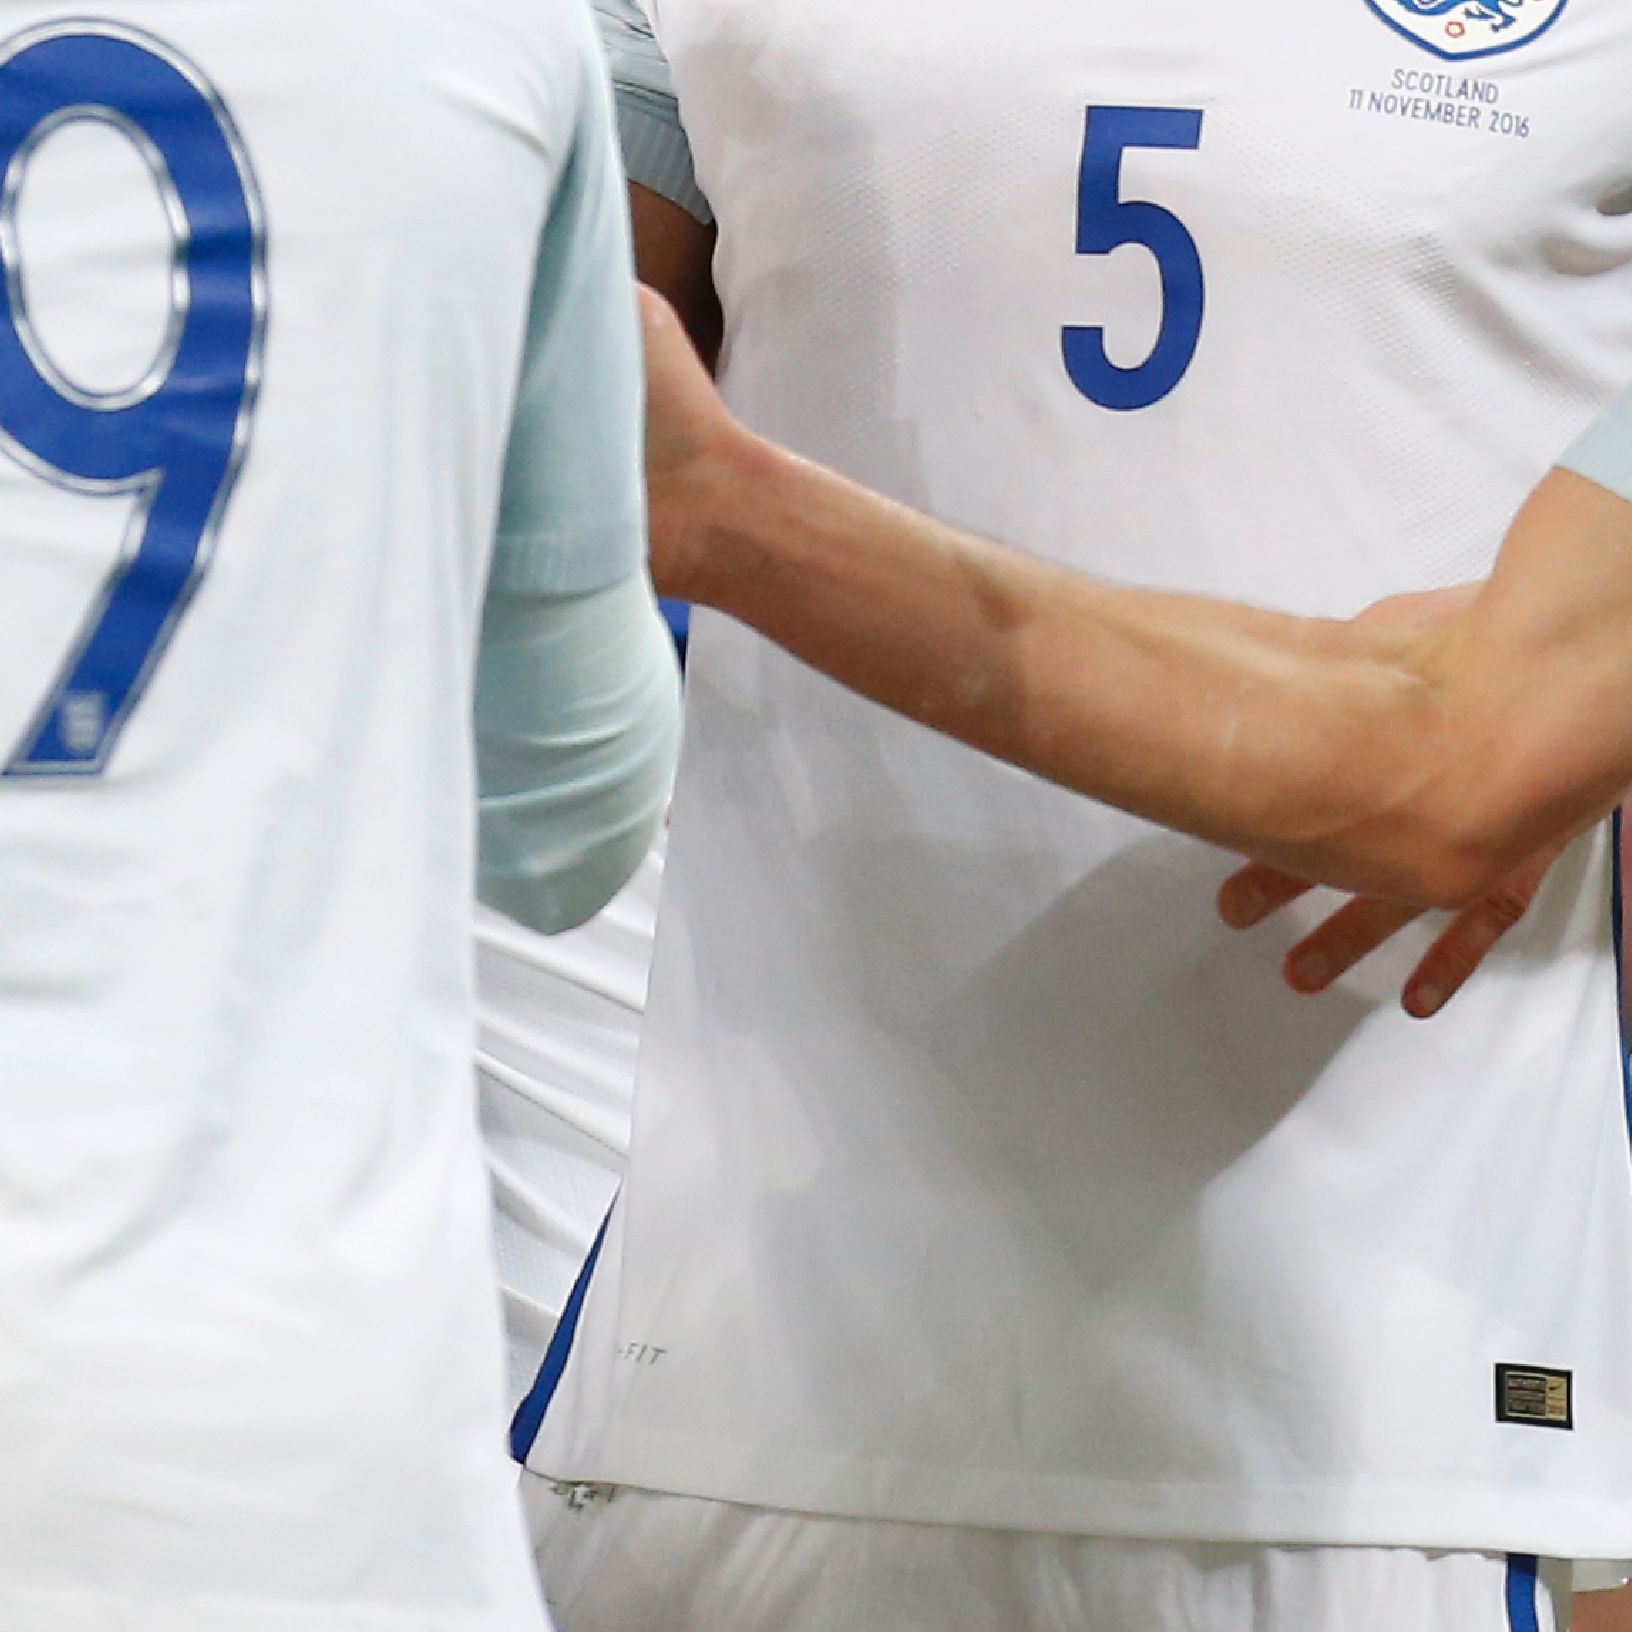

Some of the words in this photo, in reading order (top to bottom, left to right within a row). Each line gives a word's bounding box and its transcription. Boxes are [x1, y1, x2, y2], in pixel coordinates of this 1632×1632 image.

[1391, 68, 1499, 104] SCOTLAND
[1349, 88, 1364, 110] 11
[1367, 91, 1482, 129] NOVEMBER
[1488, 109, 1530, 138] 2016
[1061, 104, 1205, 411] 5
